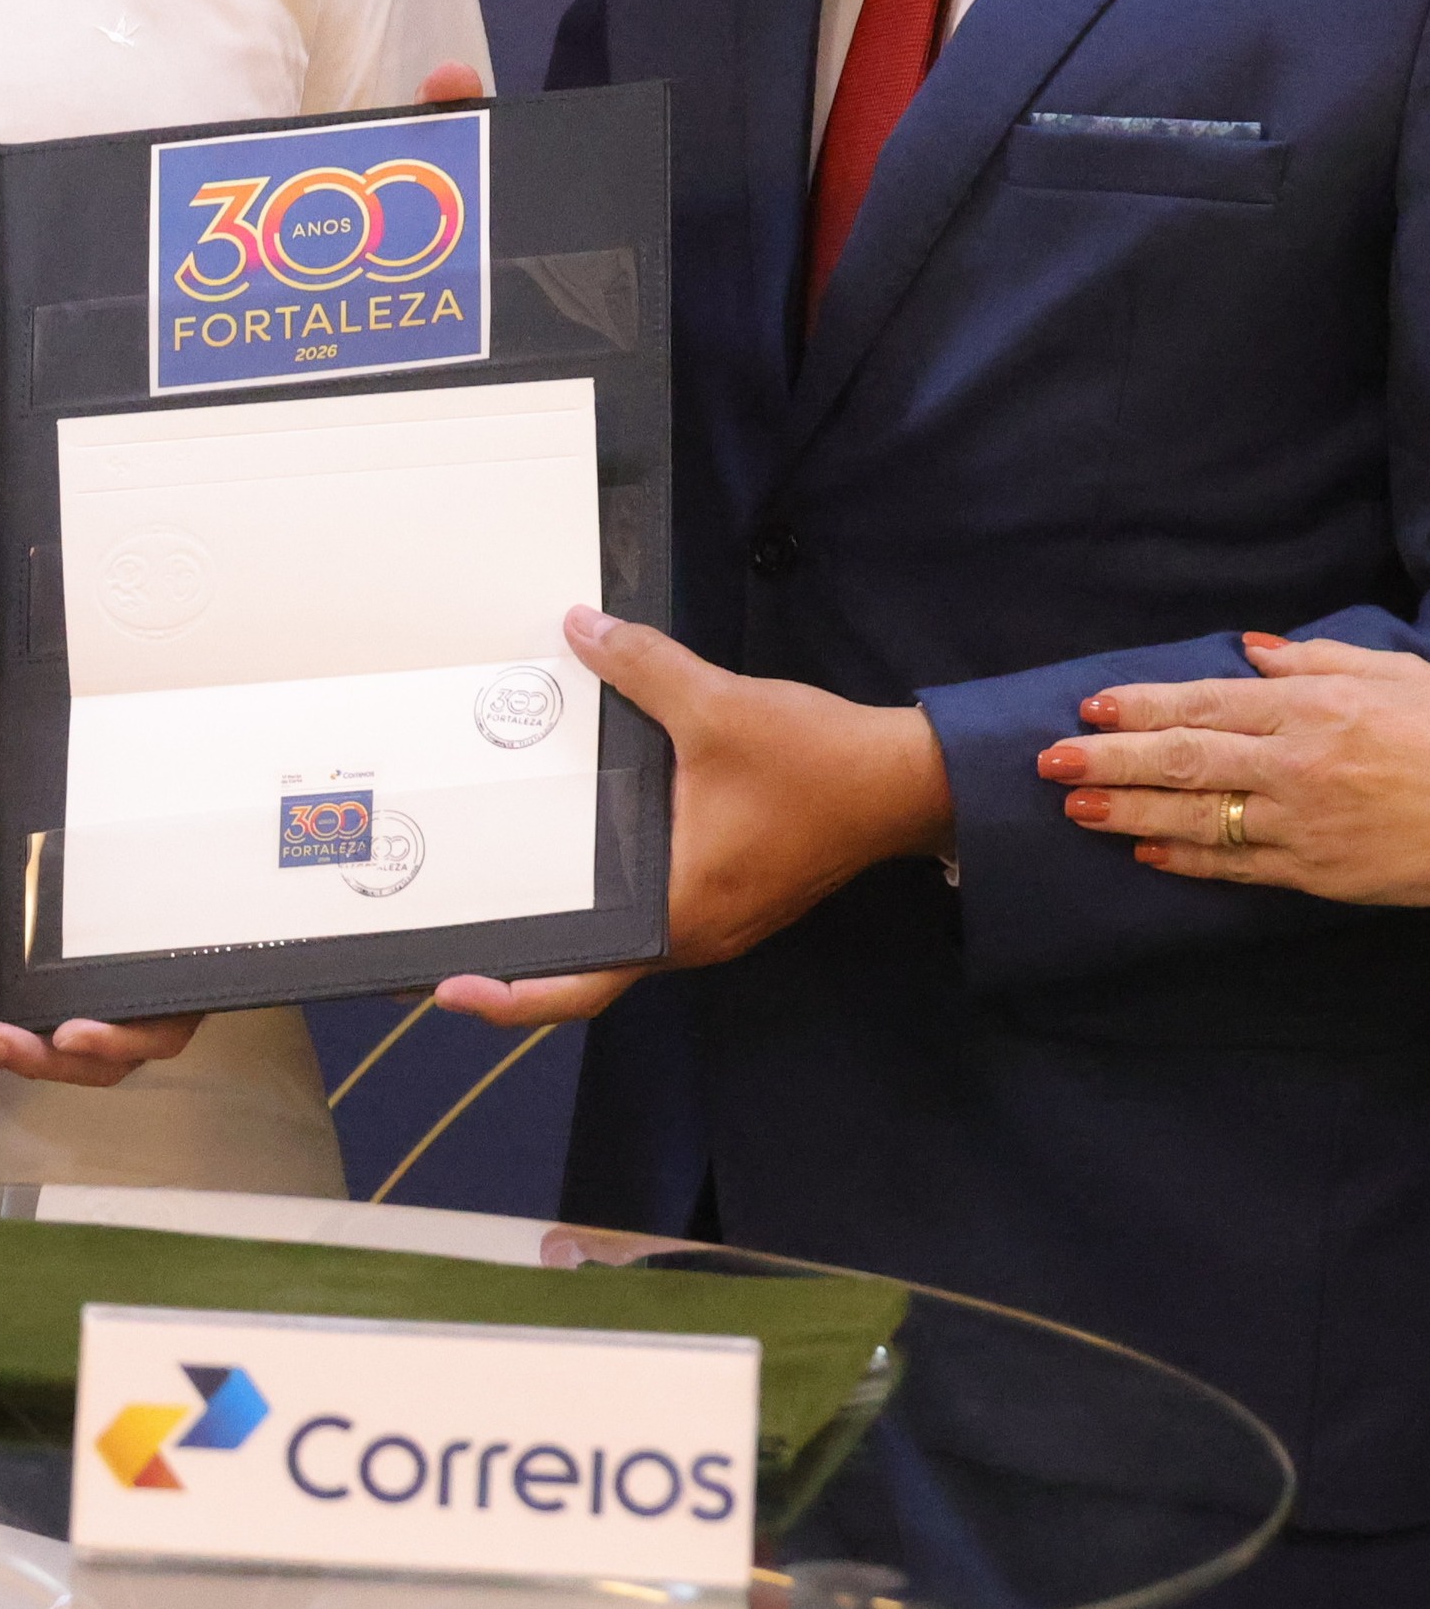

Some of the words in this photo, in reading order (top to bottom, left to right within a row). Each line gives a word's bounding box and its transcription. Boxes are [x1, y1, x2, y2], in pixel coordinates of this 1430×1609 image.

[174, 159, 465, 302] 300
[291, 217, 352, 239] ANOS
[173, 288, 465, 351] FORTALEZA
[294, 343, 338, 363] 2026
[490, 689, 548, 716] 300
[486, 712, 543, 727] FORTALEZA
[284, 801, 368, 844] 300
[282, 840, 367, 858] FORTALEZA
[286, 1413, 735, 1522] Correios
